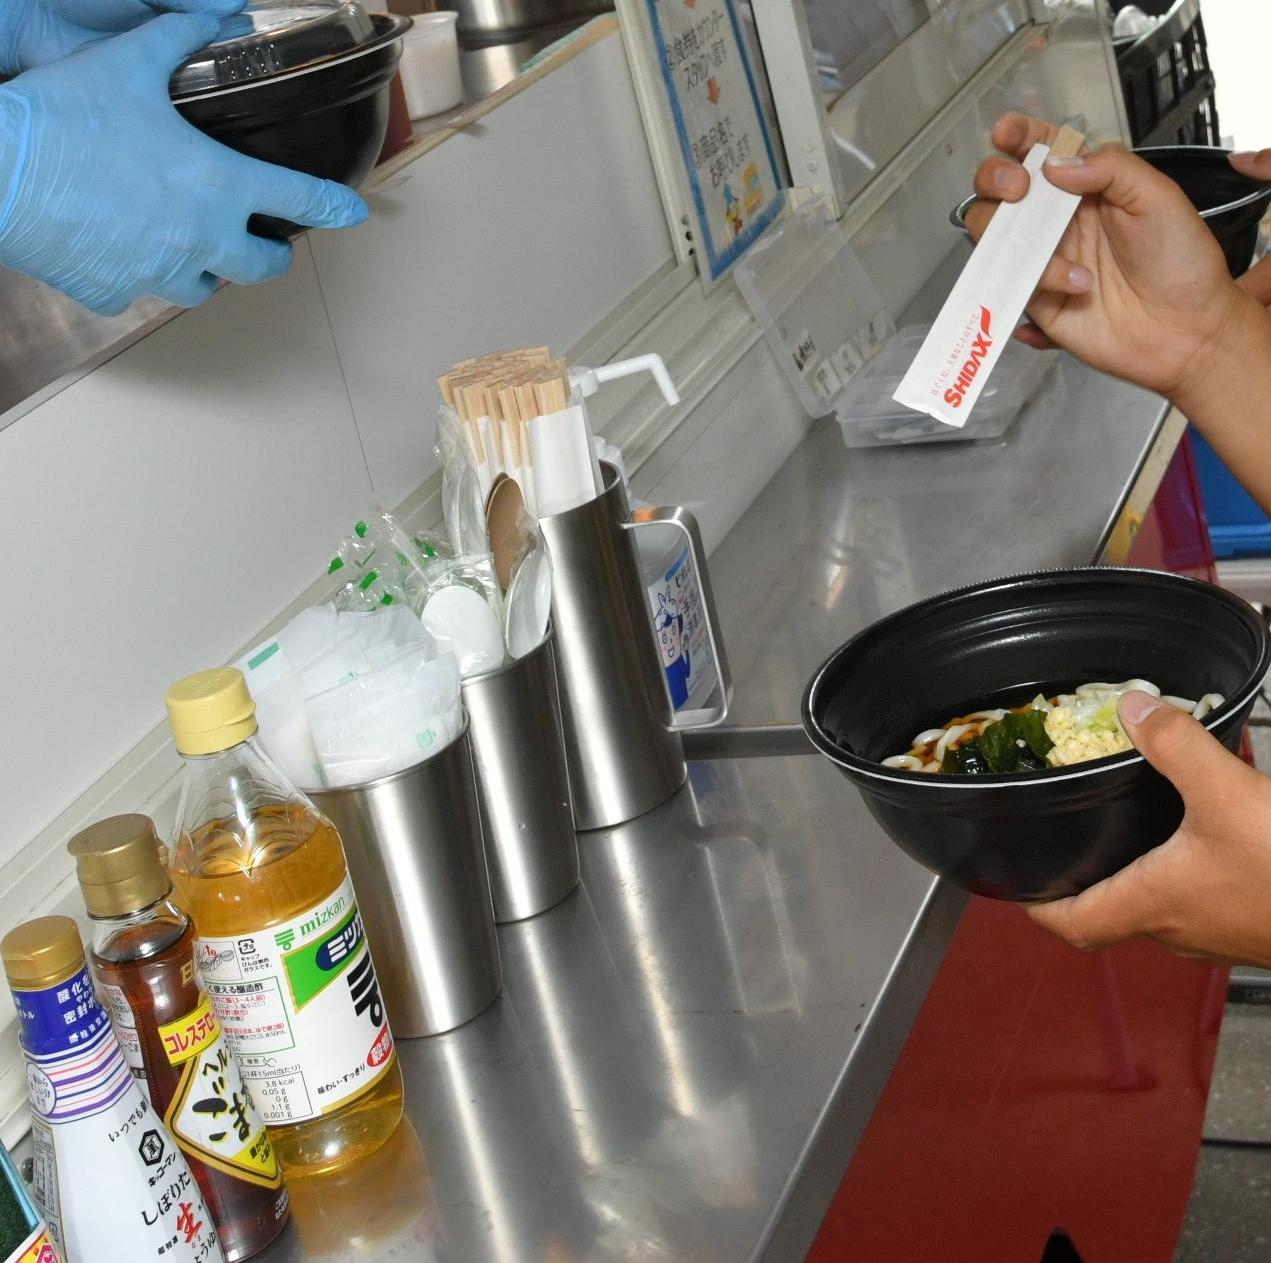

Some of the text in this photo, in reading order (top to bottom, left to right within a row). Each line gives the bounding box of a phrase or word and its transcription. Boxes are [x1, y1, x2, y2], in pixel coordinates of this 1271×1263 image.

[944, 332, 994, 409] SHIDAX
[300, 897, 346, 937] mizkan
[165, 1015, 219, 1056] コレステロ
[147, 1152, 178, 1187] キッコーマン
[176, 1201, 203, 1244] 生
